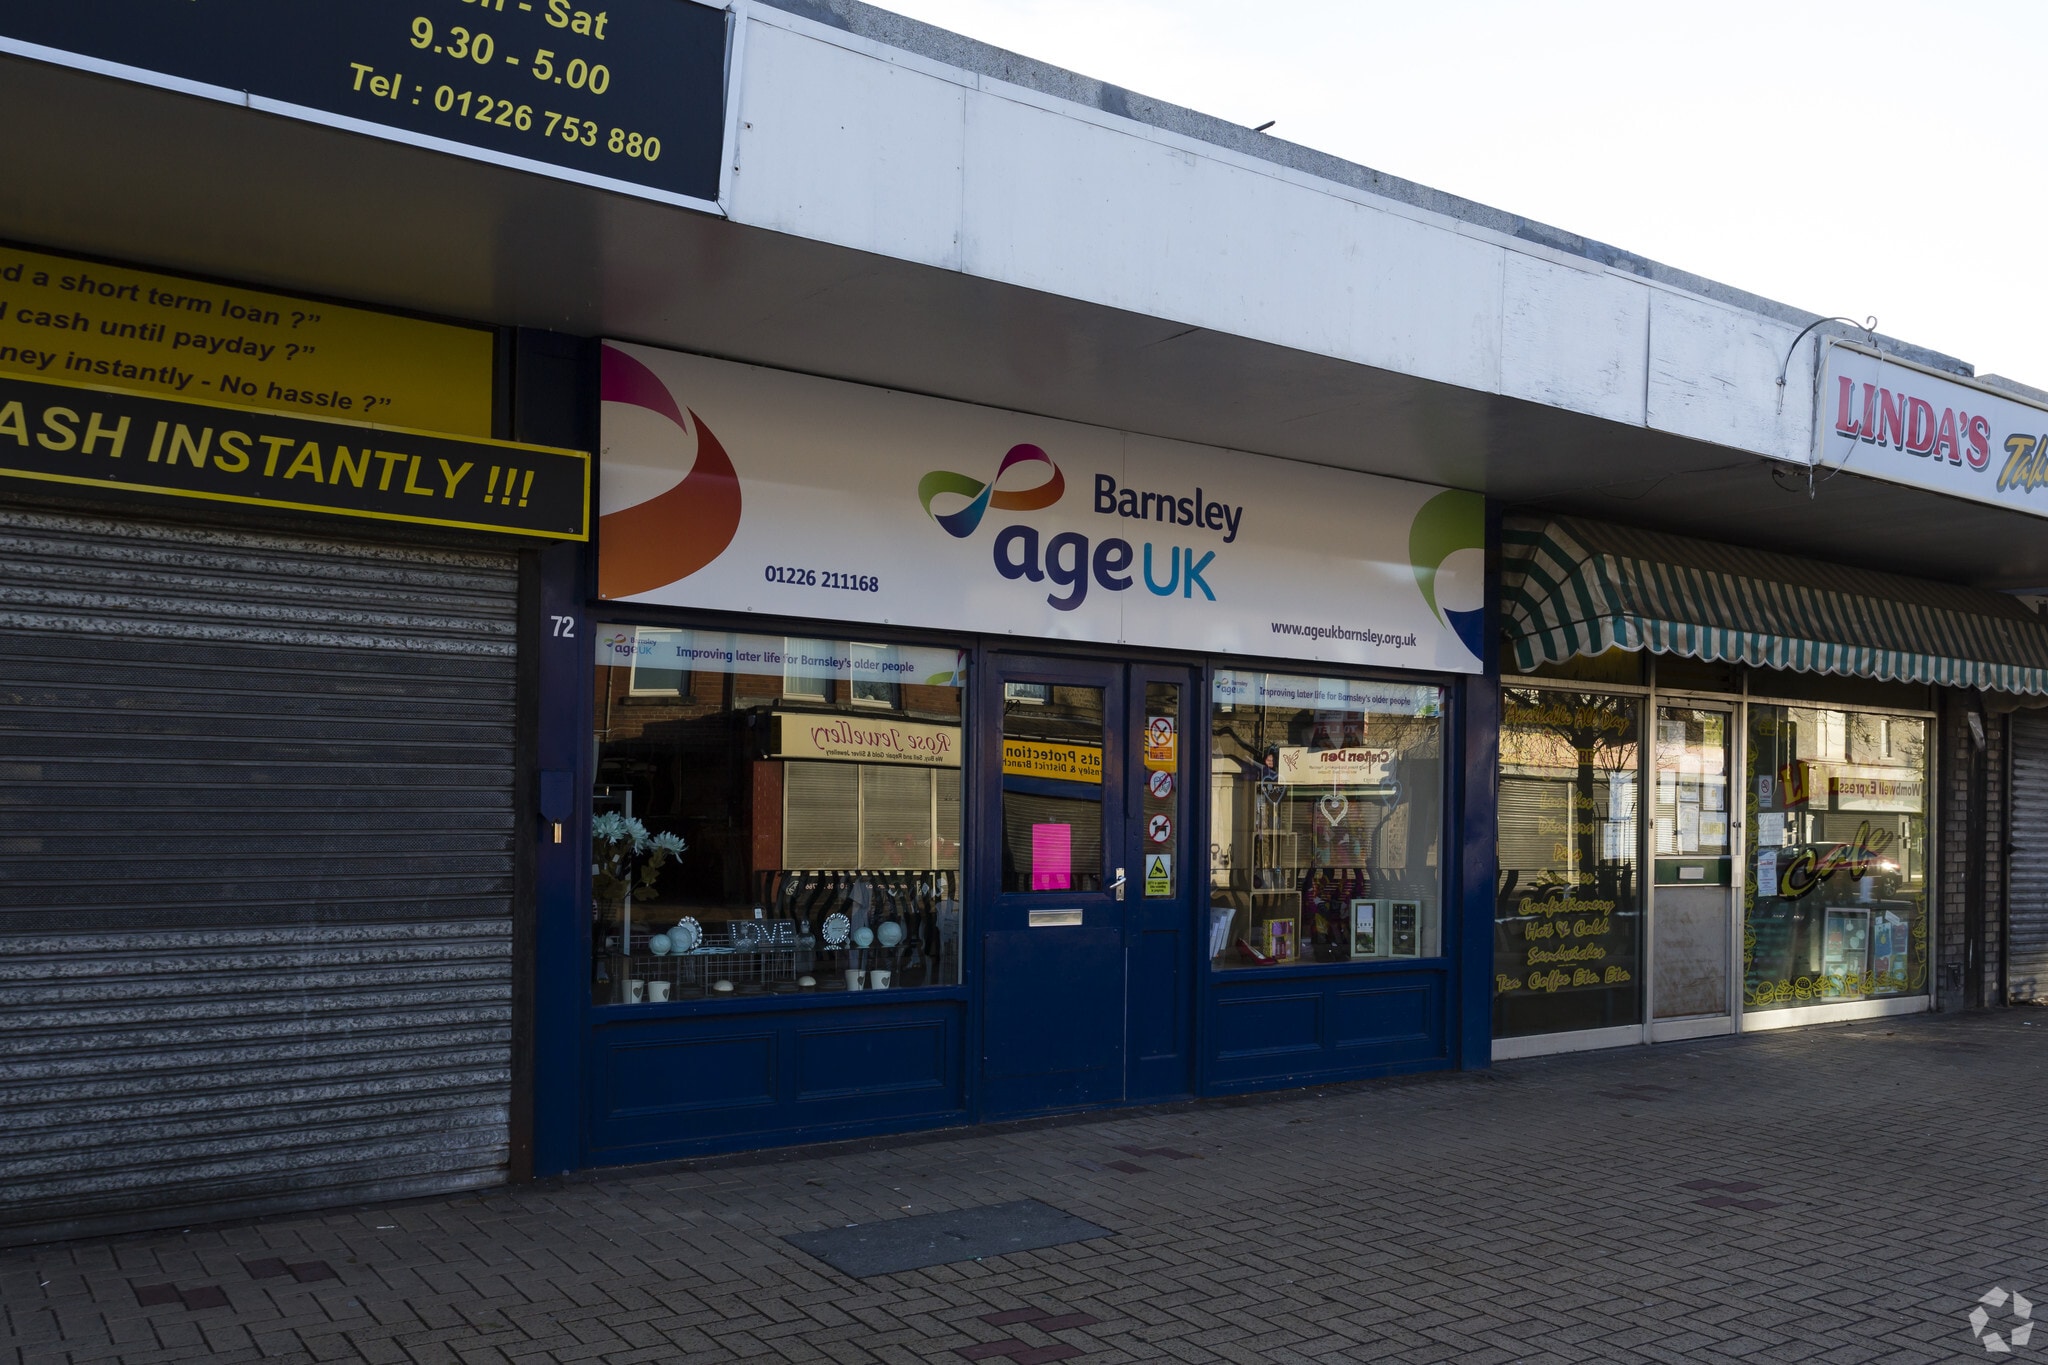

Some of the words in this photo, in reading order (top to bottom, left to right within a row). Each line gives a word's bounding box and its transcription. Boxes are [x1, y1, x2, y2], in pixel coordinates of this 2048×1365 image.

[544, 0, 609, 40] Sat
[410, 17, 494, 64] 9.30
[532, 49, 610, 95] 5.00
[350, 62, 402, 99] Tel
[434, 85, 533, 131] 01226
[544, 111, 598, 147] 753
[607, 128, 661, 161] 880
[33, 271, 49, 287] a
[59, 274, 140, 301] short
[149, 288, 212, 314] term
[221, 300, 280, 325] loan
[16, 308, 90, 332] cash
[101, 319, 165, 342] until
[172, 330, 276, 363] payday
[65, 352, 194, 391] instantly
[219, 375, 258, 396] No
[266, 382, 353, 410] hassle
[1836, 376, 1990, 472] LINDA'S
[148, 421, 474, 499] INSTANTLY
[484, 467, 535, 507] !!!
[1094, 473, 1243, 544] Barnsley
[765, 565, 816, 586] 01226
[821, 571, 879, 593] 211168
[551, 615, 575, 638] 72
[1271, 622, 1417, 649] www.ageukbarnsley.org.uk
[676, 646, 733, 663] Improving
[735, 650, 760, 663] later
[763, 652, 781, 664] life
[854, 660, 880, 671] older
[882, 663, 915, 674] people
[1259, 687, 1296, 700] Improving
[1297, 688, 1314, 699] later
[1314, 691, 1326, 700] life
[1327, 692, 1337, 701] for
[1372, 696, 1389, 705] older
[1390, 698, 1411, 707] people
[1518, 896, 1615, 918] Confectionery
[1525, 921, 1554, 941] Hot
[1573, 918, 1610, 937] Cold
[1527, 942, 1606, 965] Sandwiches
[1496, 974, 1521, 992] Tea
[1528, 969, 1571, 992] Coffee
